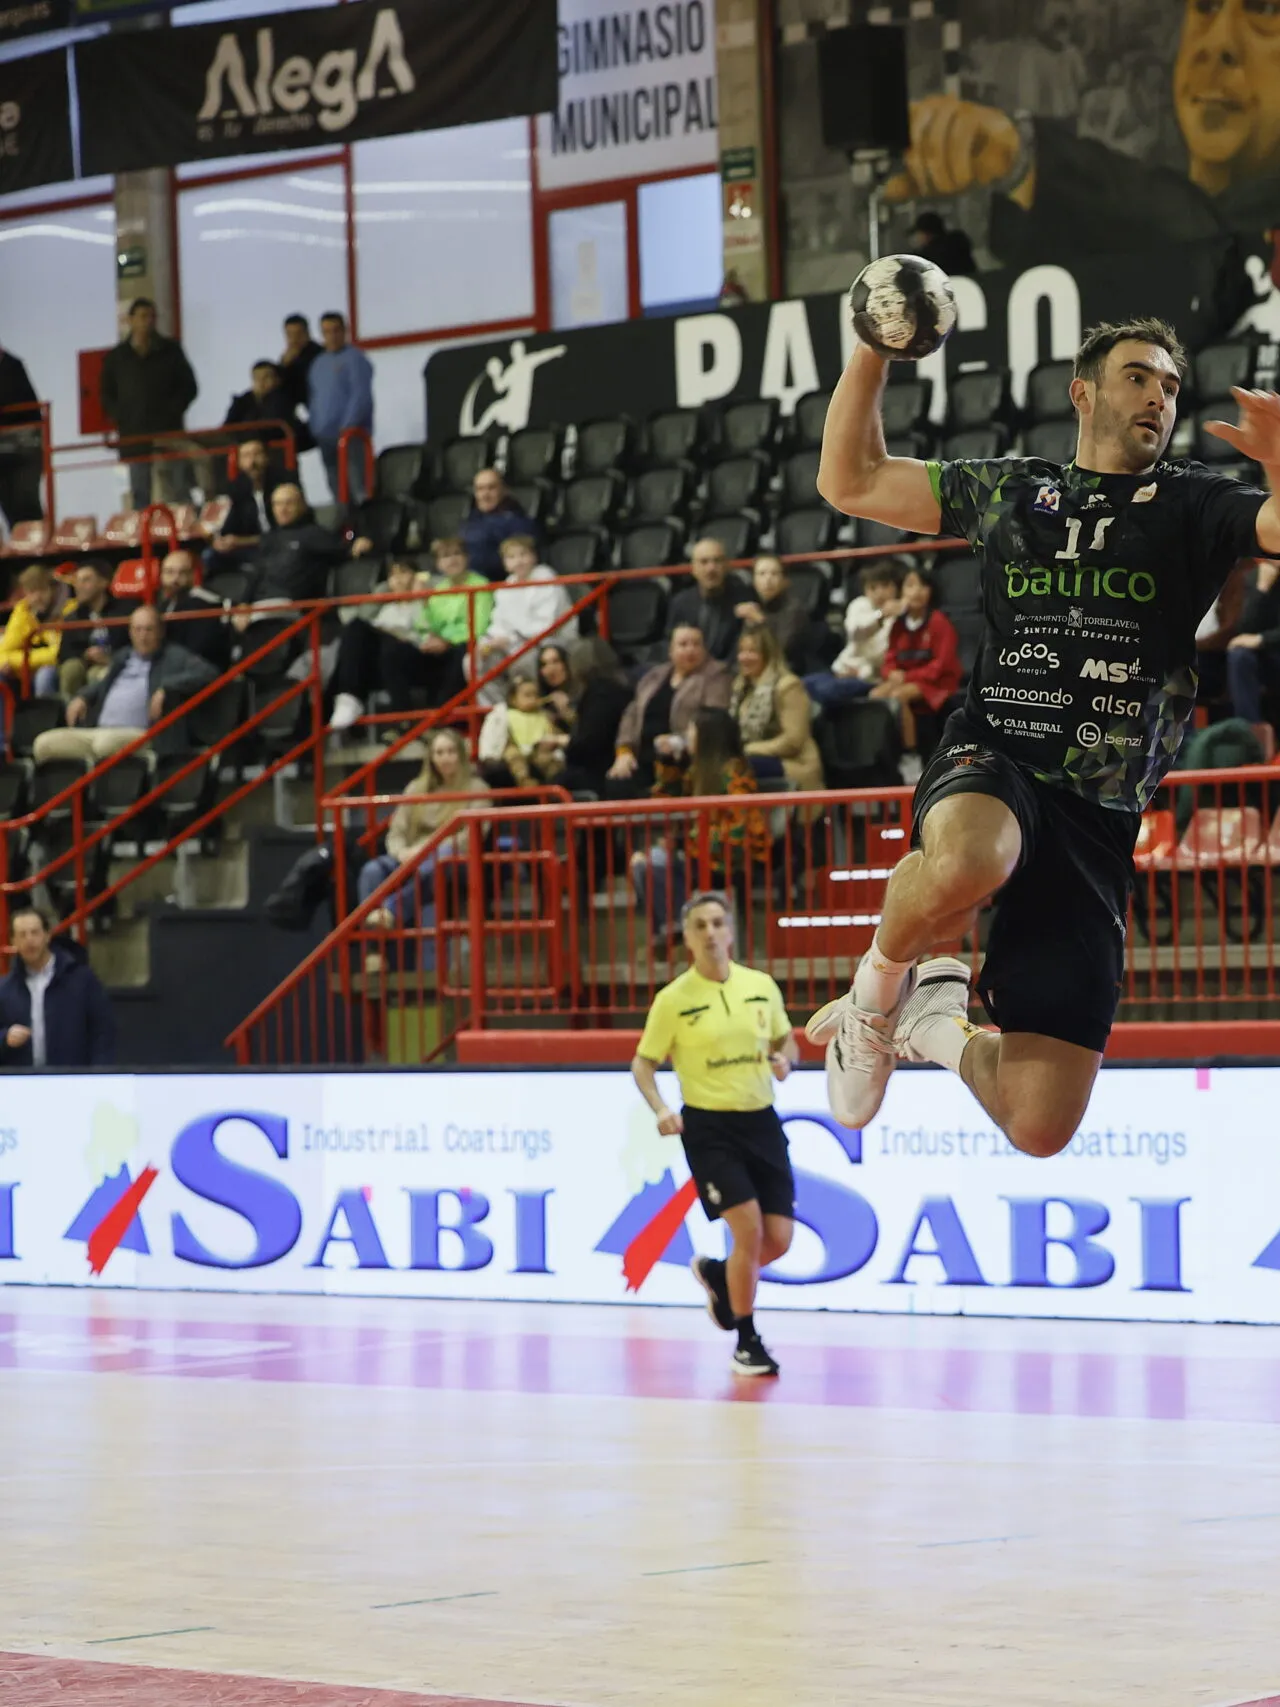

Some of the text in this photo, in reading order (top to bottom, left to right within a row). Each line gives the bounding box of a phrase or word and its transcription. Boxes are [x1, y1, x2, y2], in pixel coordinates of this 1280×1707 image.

[557, 0, 705, 78] GIMNASIO
[551, 77, 719, 156] MUNICIPAL
[1016, 667, 1048, 676] energía
[1079, 658, 1129, 683] MS
[979, 682, 1074, 705] mimoondo
[1091, 694, 1142, 718] alsa
[1003, 718, 1064, 734] CAJA RURAL
[1014, 730, 1046, 739] ASTURIAS
[1104, 732, 1144, 747] benzi
[302, 1123, 553, 1161] Industrial Coatings
[879, 1124, 1187, 1165] Industri oatings
[170, 1109, 556, 1274] SABI
